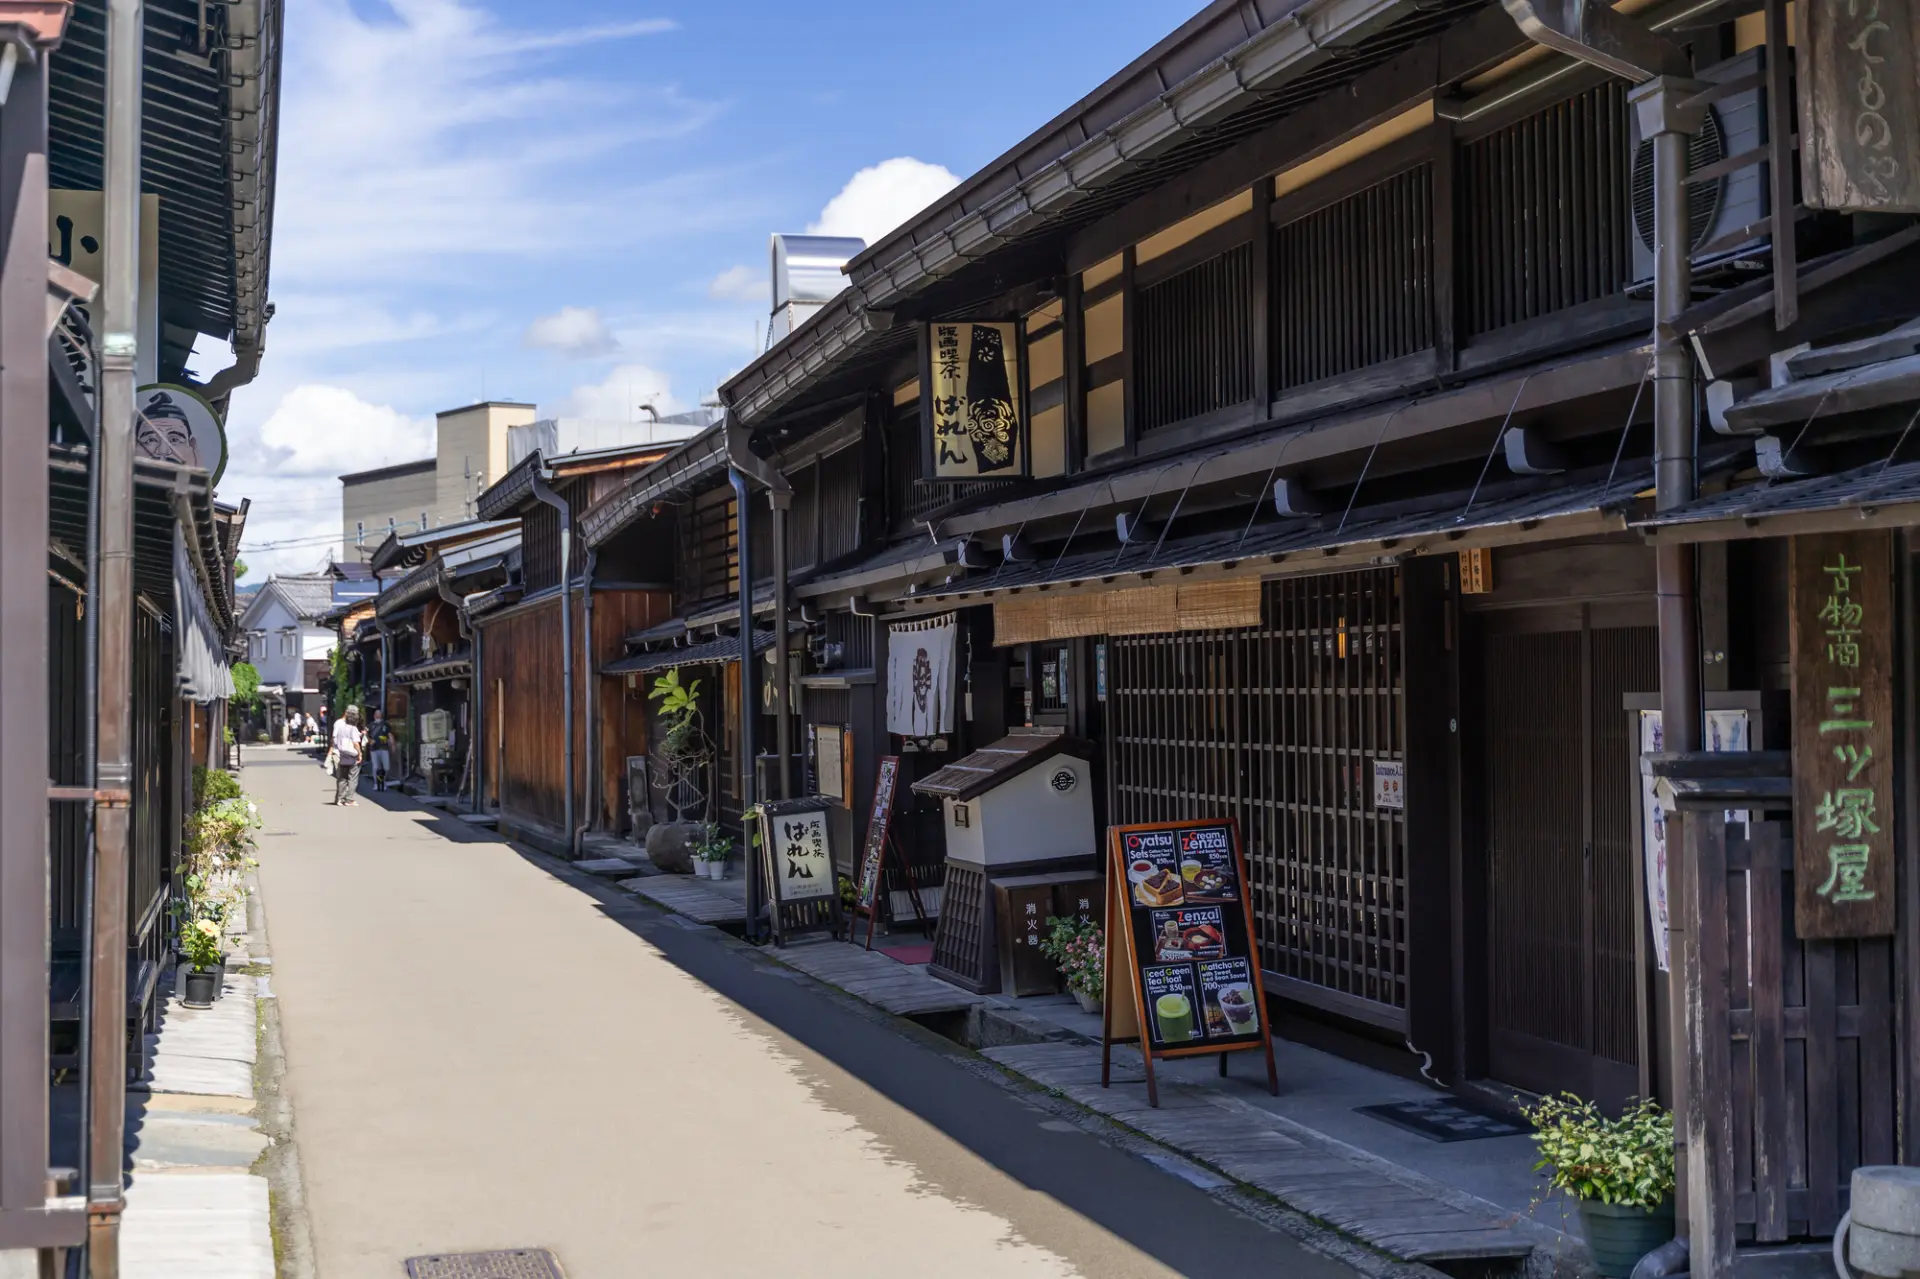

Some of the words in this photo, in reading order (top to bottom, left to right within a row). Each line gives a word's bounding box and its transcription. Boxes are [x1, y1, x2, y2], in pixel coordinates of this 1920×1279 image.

[938, 326, 961, 379] 版画喫茶
[935, 395, 968, 466] ばれん
[1818, 553, 1863, 668] 古物商
[1816, 687, 1881, 903] 三ツ塚屋
[1128, 834, 1172, 850] Oyatsu
[1182, 835, 1226, 850] Zenzai
[1190, 832, 1220, 840] Cream
[784, 821, 814, 879] ばれん
[1130, 850, 1149, 859] Sets
[1177, 908, 1220, 922] Zenzai
[1025, 903, 1038, 945] 消火器
[1146, 969, 1165, 977] Iced
[1165, 968, 1190, 976] Green
[1148, 978, 1162, 986] Tea
[1162, 975, 1182, 984] Float
